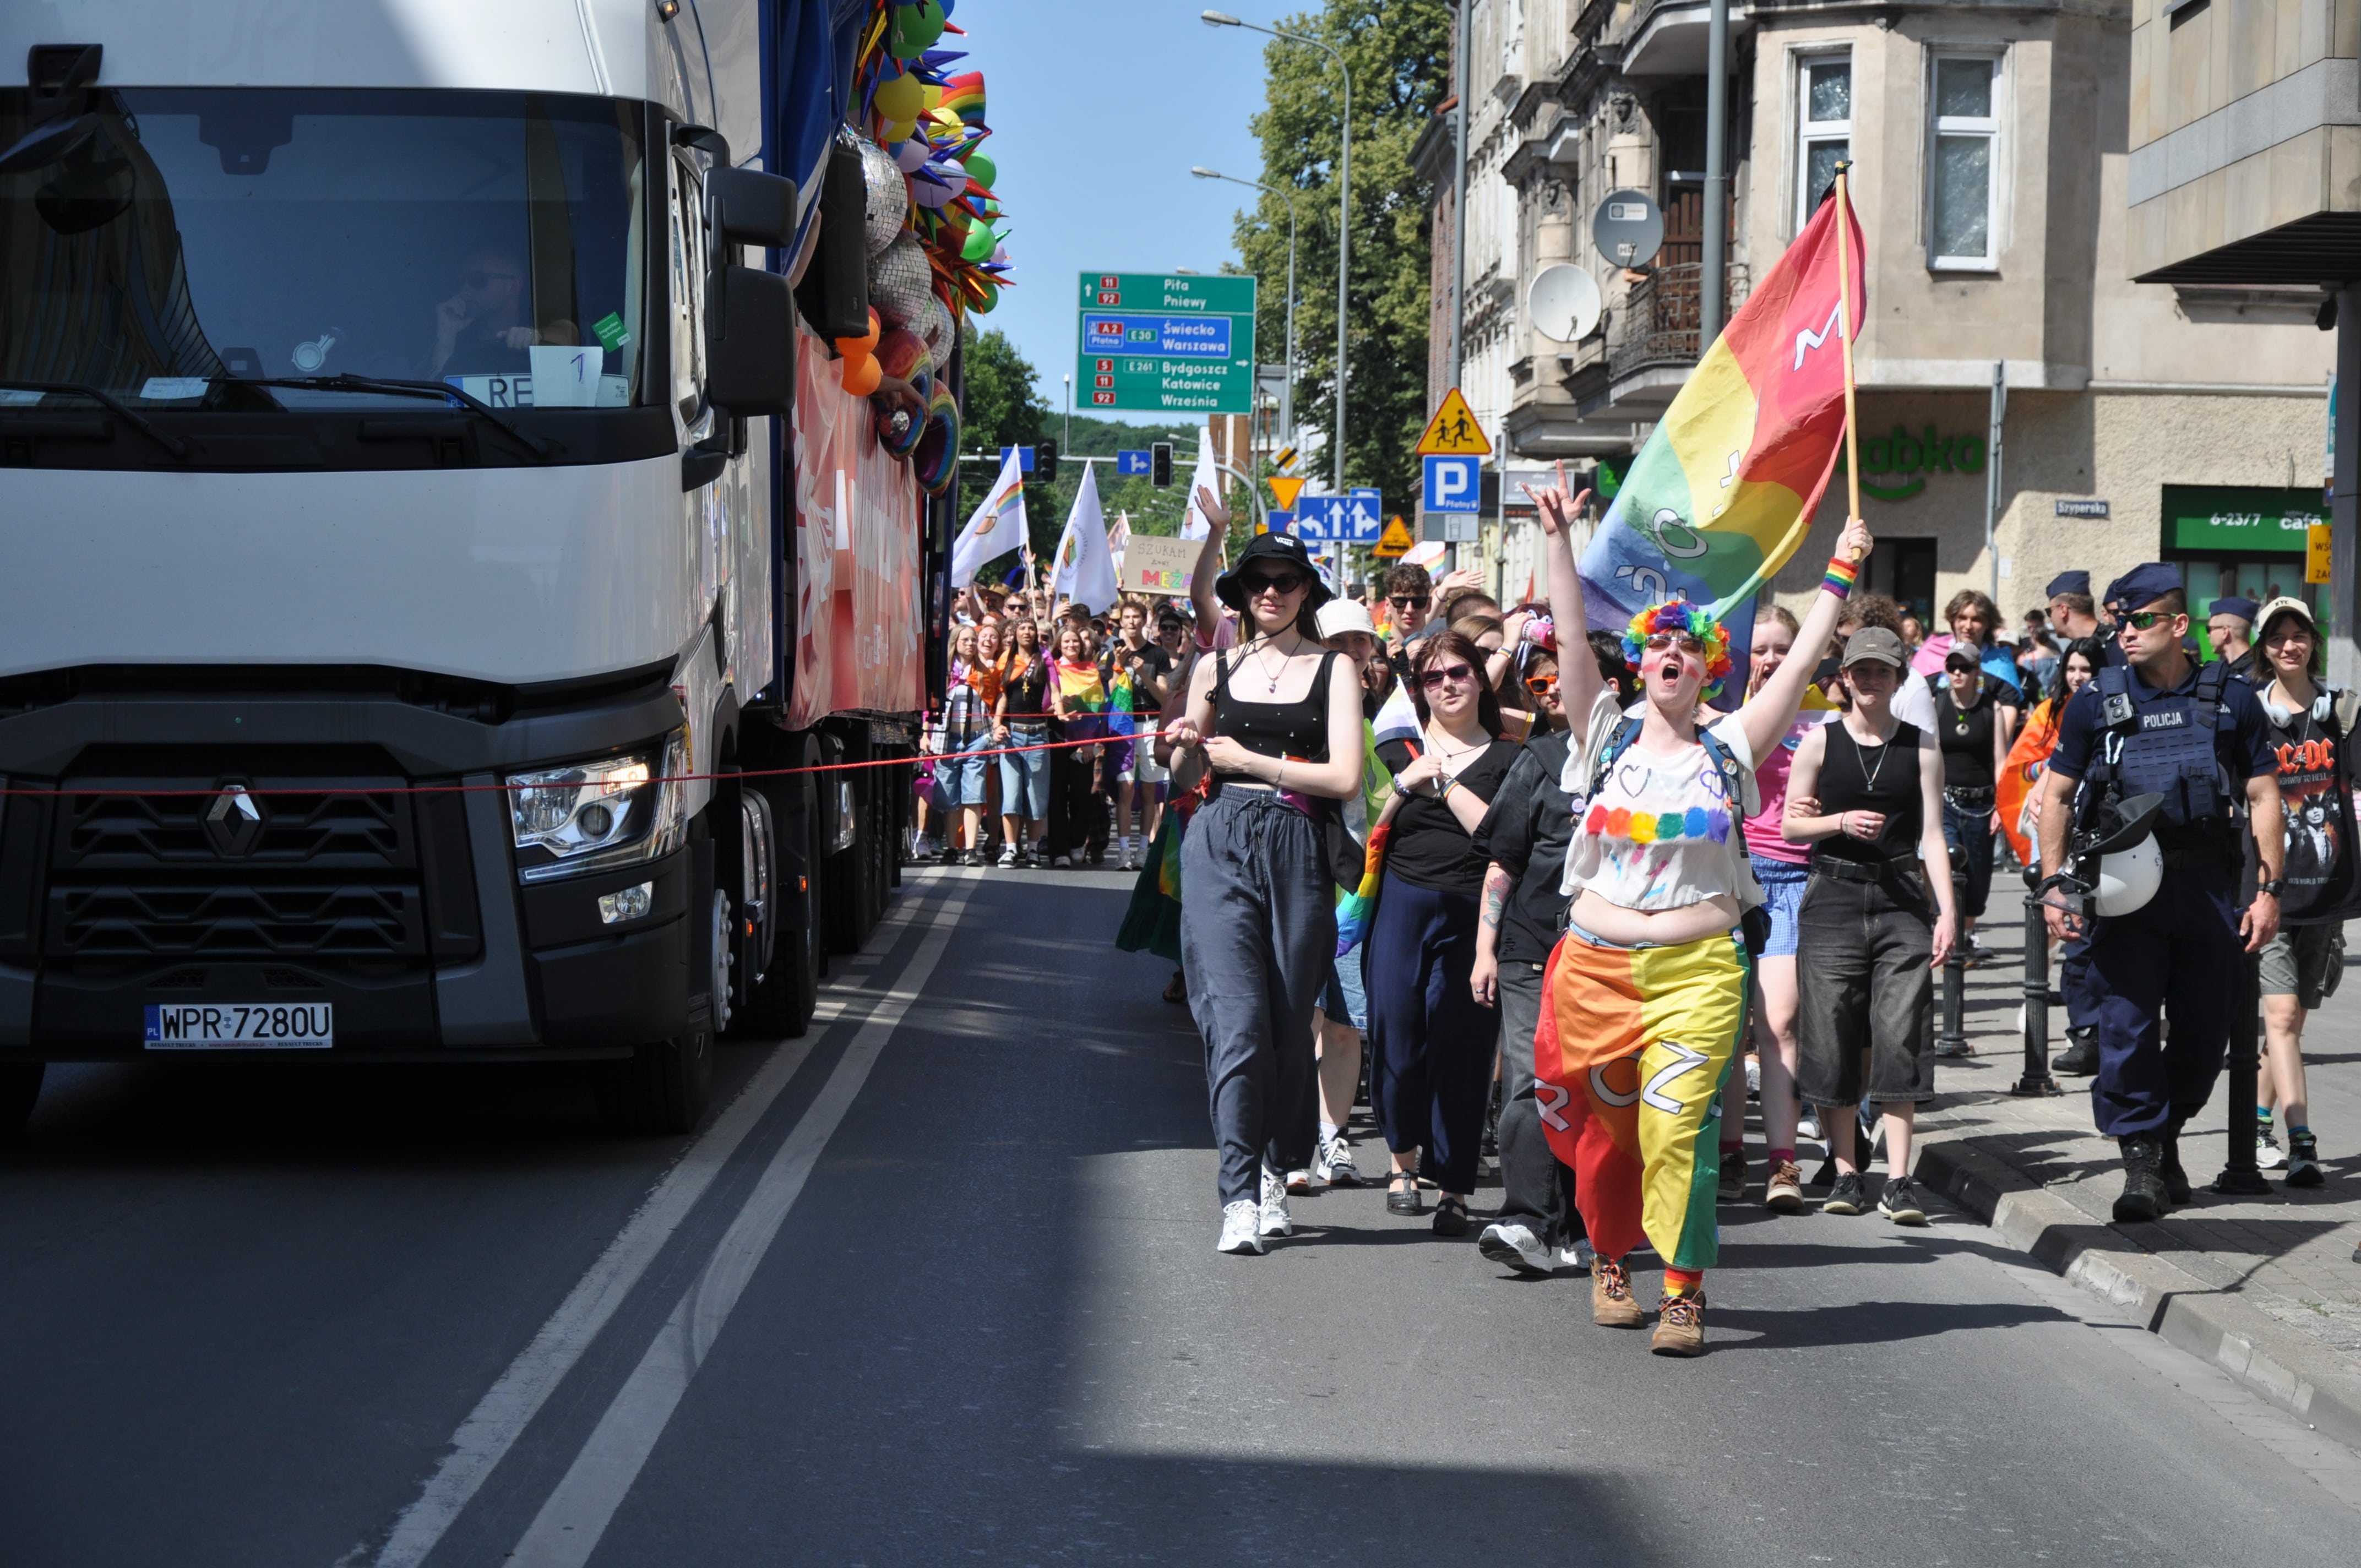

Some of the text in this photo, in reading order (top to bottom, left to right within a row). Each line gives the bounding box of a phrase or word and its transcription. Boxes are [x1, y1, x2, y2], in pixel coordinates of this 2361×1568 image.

[1164, 279, 1189, 291] Piła
[1164, 295, 1206, 310] Pniewy
[1163, 320, 1215, 335] Świecko
[1092, 336, 1119, 345] Płatna
[1138, 331, 1151, 340] 30
[1162, 339, 1226, 352] Warszawa
[1101, 362, 1108, 370] 5
[1137, 362, 1152, 371] 261
[1162, 362, 1228, 377] Bydgoszcz
[1100, 377, 1108, 385] 11
[1162, 378, 1221, 391] Katowice
[1097, 394, 1110, 402] 92
[1161, 394, 1218, 407] Września
[1837, 425, 1985, 473] abka
[1435, 462, 1467, 507] P
[1445, 500, 1471, 510] Płatny
[2058, 501, 2107, 515] Szyperska
[1274, 536, 1294, 547] VANS
[1138, 543, 1185, 558] SZUKAM
[2144, 712, 2183, 728] POLICJA
[162, 1006, 329, 1039] WPR 7280U
[147, 1028, 159, 1036] PL
